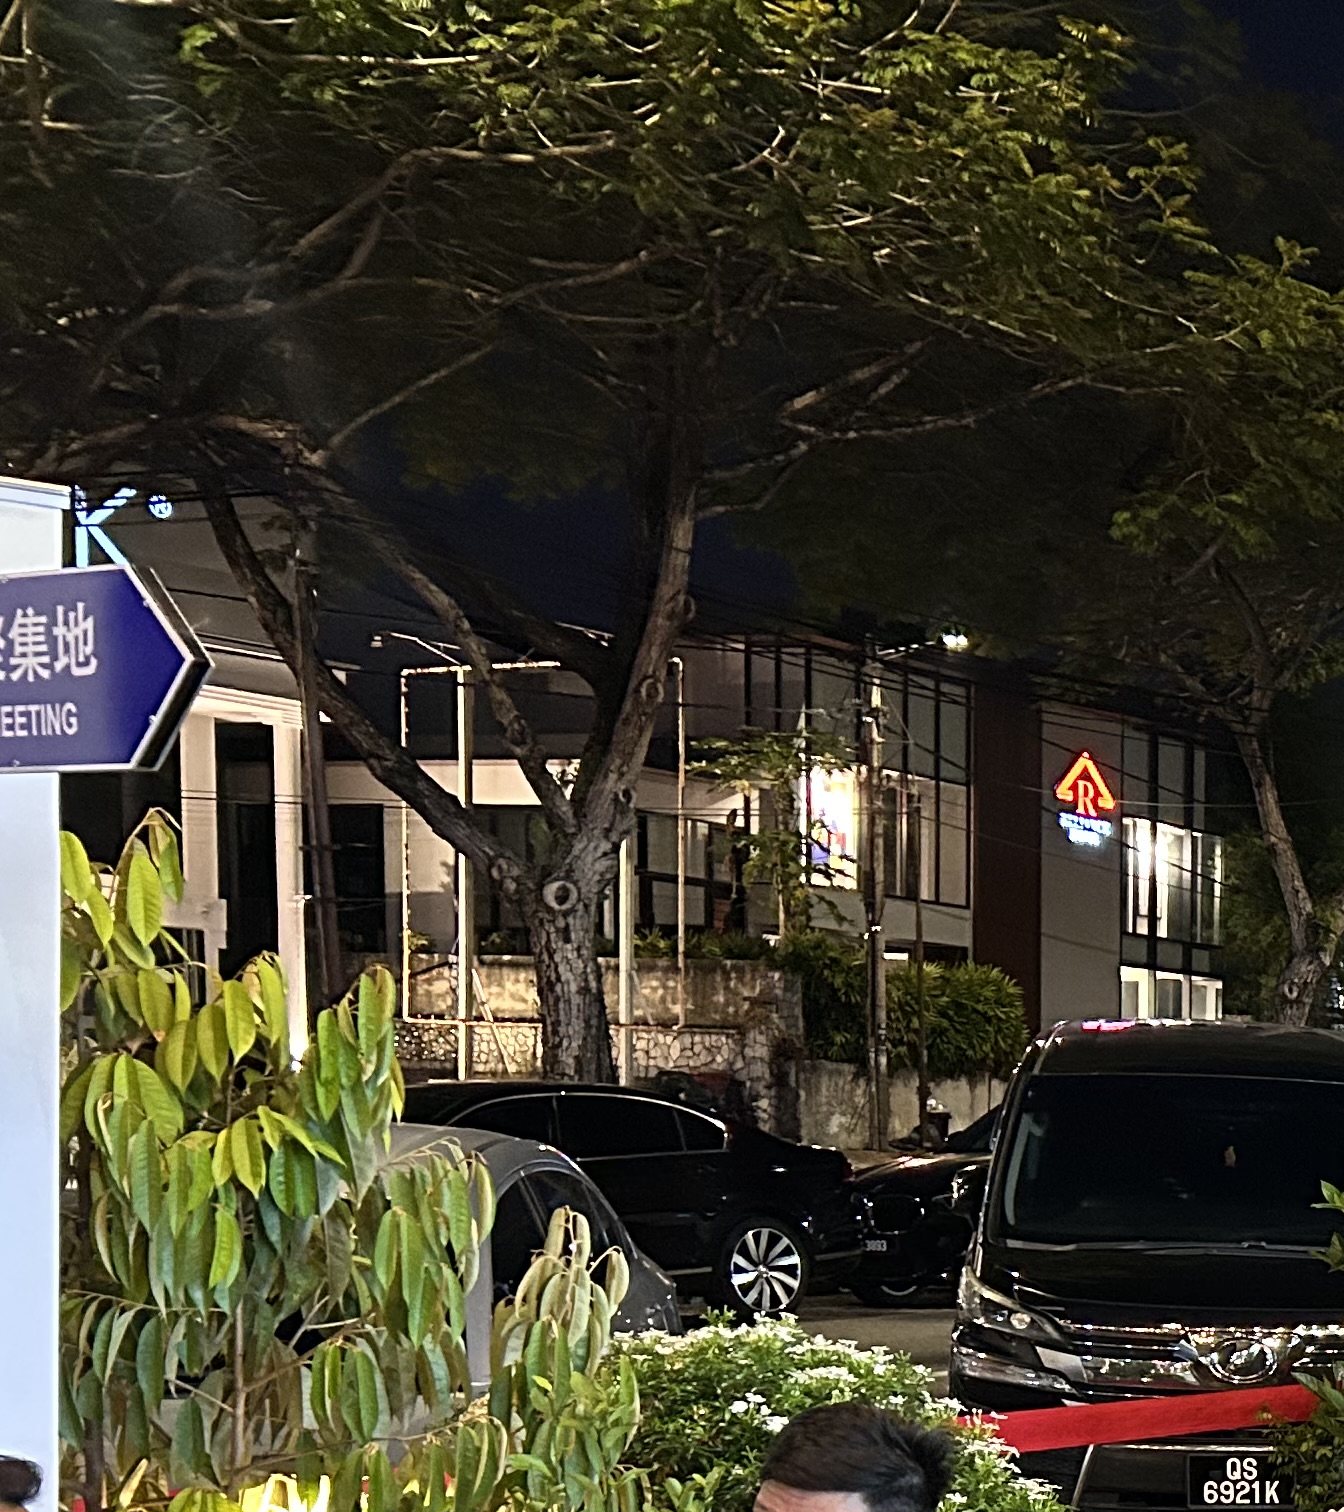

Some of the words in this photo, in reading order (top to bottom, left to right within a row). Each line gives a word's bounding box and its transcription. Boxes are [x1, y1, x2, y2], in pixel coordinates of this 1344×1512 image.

[0, 602, 98, 683] 集地
[0, 702, 79, 737] EETING
[1076, 780, 1097, 817] R
[1226, 1457, 1258, 1480] QS
[1203, 1480, 1280, 1504] 6921K
